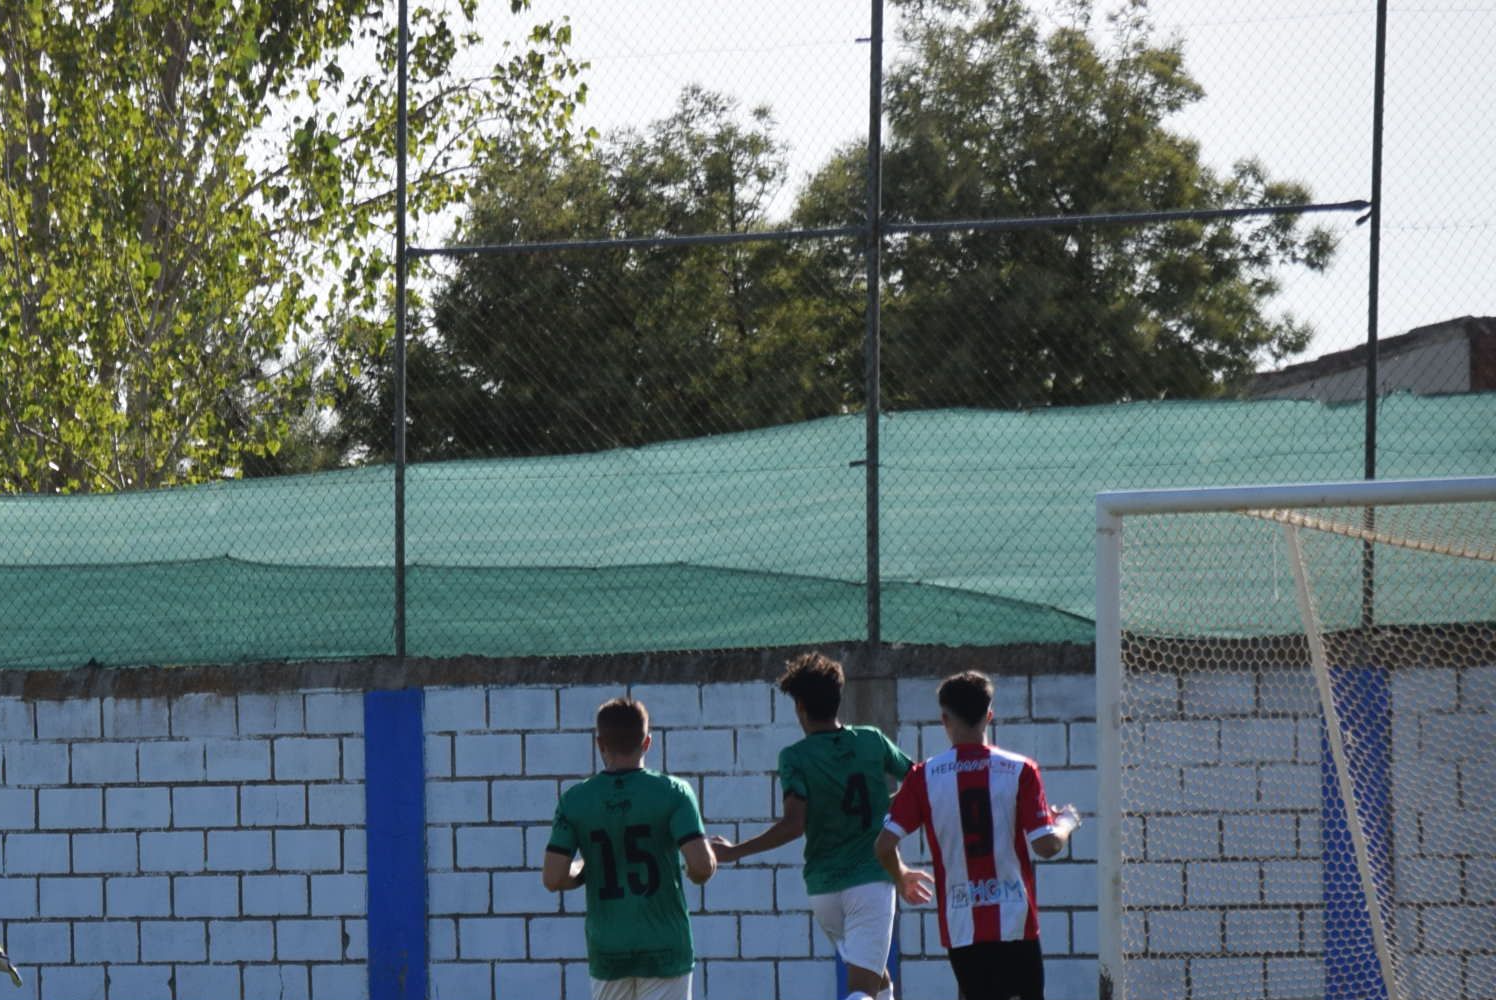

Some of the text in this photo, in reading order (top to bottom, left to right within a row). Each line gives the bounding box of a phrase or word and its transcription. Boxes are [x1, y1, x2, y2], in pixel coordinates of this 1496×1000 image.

[841, 772, 873, 832] 4
[589, 824, 661, 900] 15
[968, 879, 1023, 903] HGM
